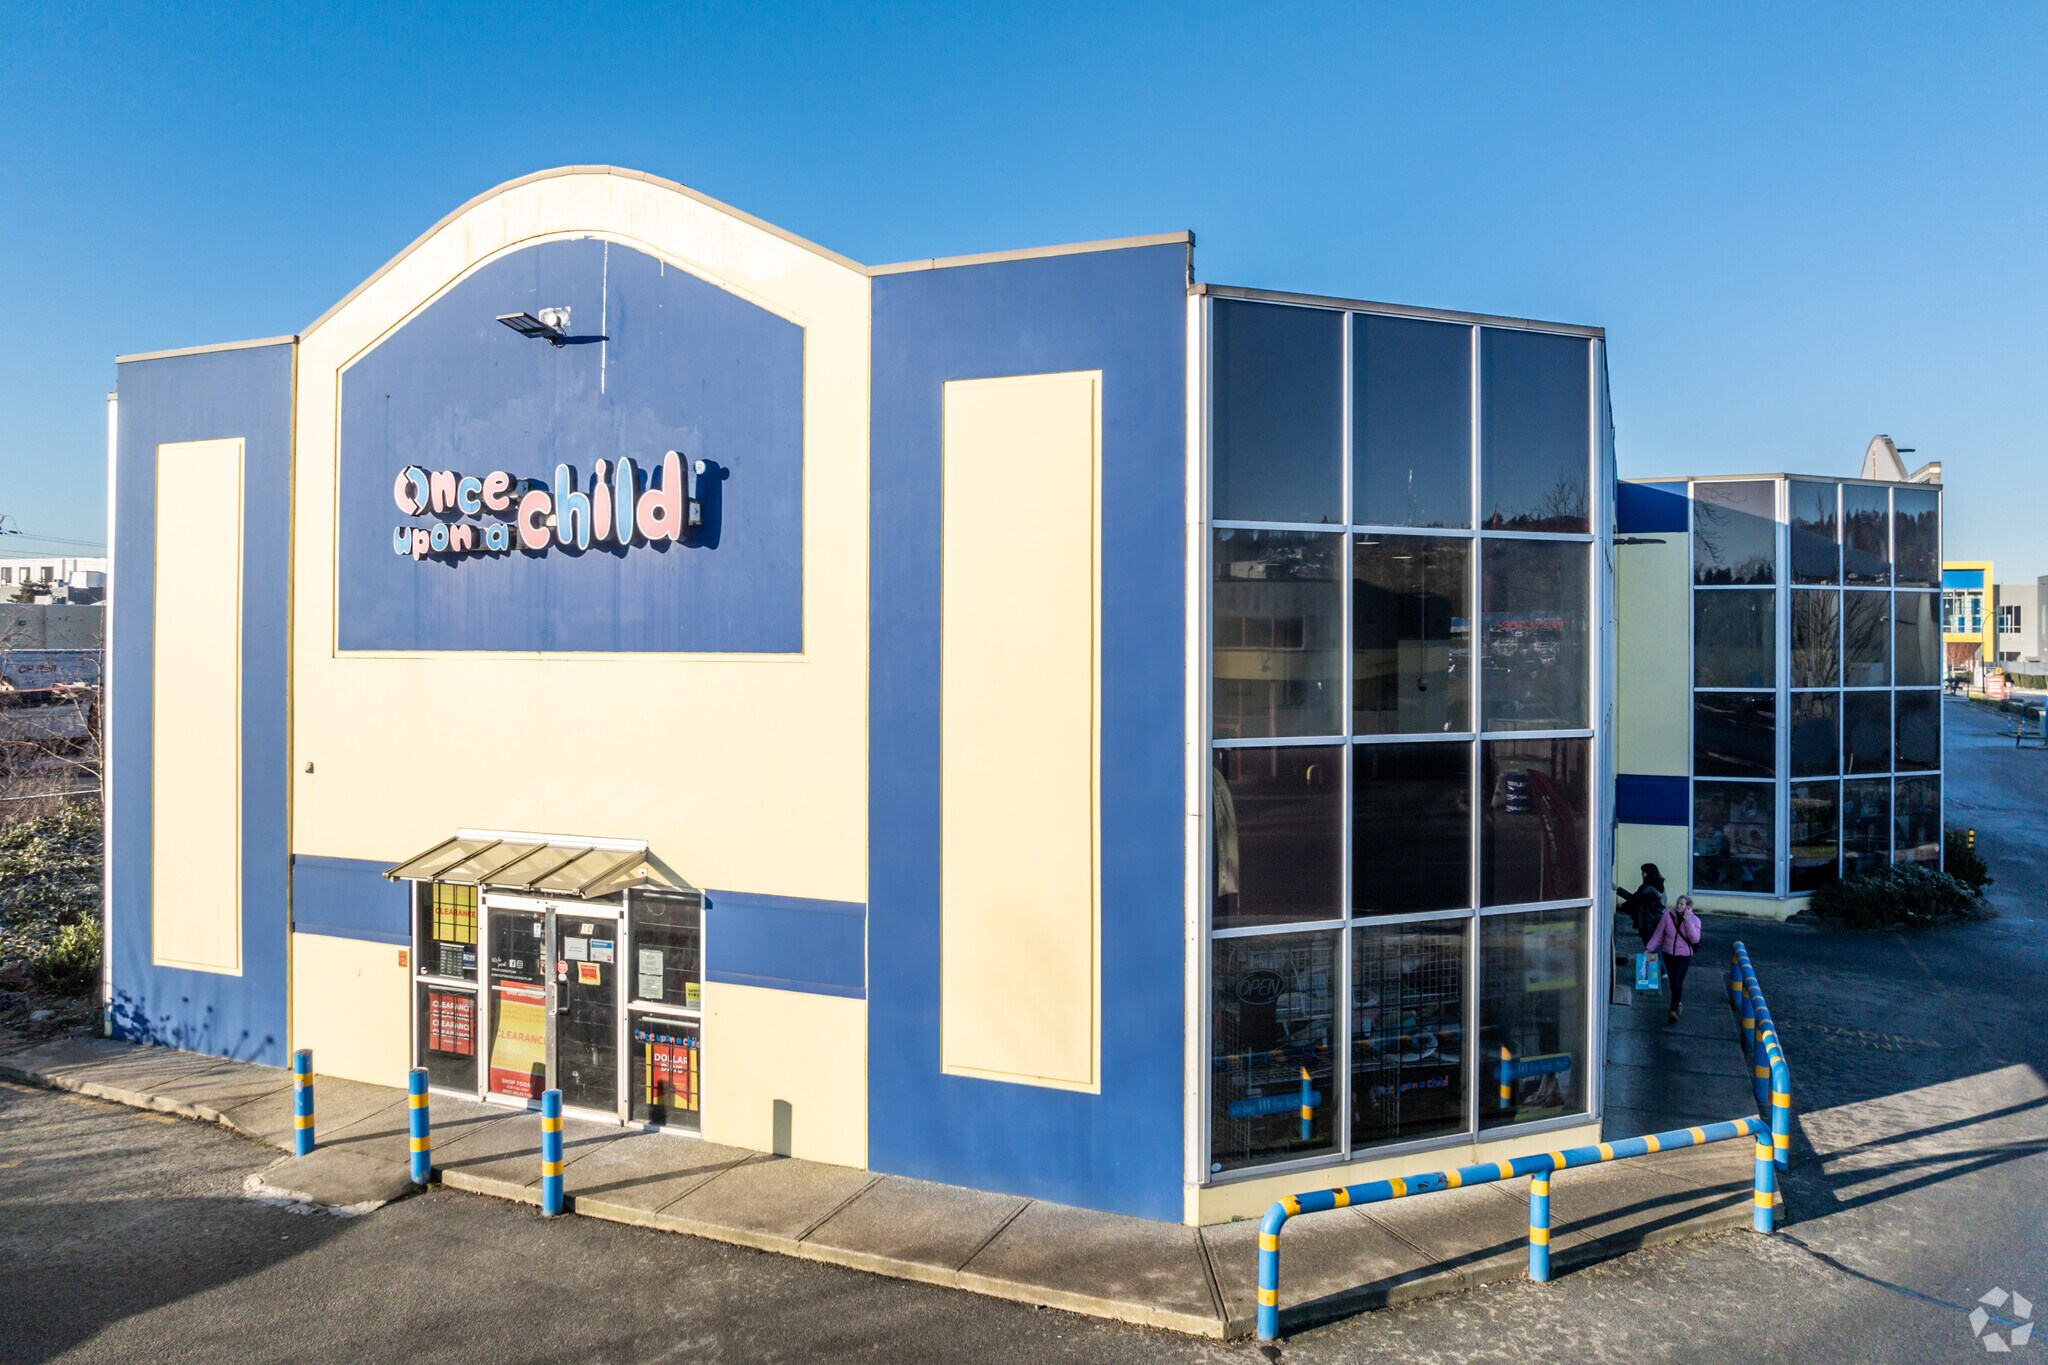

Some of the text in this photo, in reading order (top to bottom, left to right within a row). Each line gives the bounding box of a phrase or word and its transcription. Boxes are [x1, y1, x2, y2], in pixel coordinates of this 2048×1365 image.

[393, 465, 511, 516] Once
[517, 450, 685, 551] child
[393, 523, 510, 561] upon a
[435, 907, 476, 919] CLEARANCE
[582, 924, 594, 934] 10
[1239, 978, 1280, 997] OPEN
[432, 1000, 471, 1012] CEARANC
[432, 1010, 471, 1022] CEARANC
[432, 1019, 471, 1031] CEARANC
[432, 1028, 471, 1041] CEARANC
[496, 1029, 546, 1046] CLEARANC
[654, 1053, 688, 1065] DOLLAR
